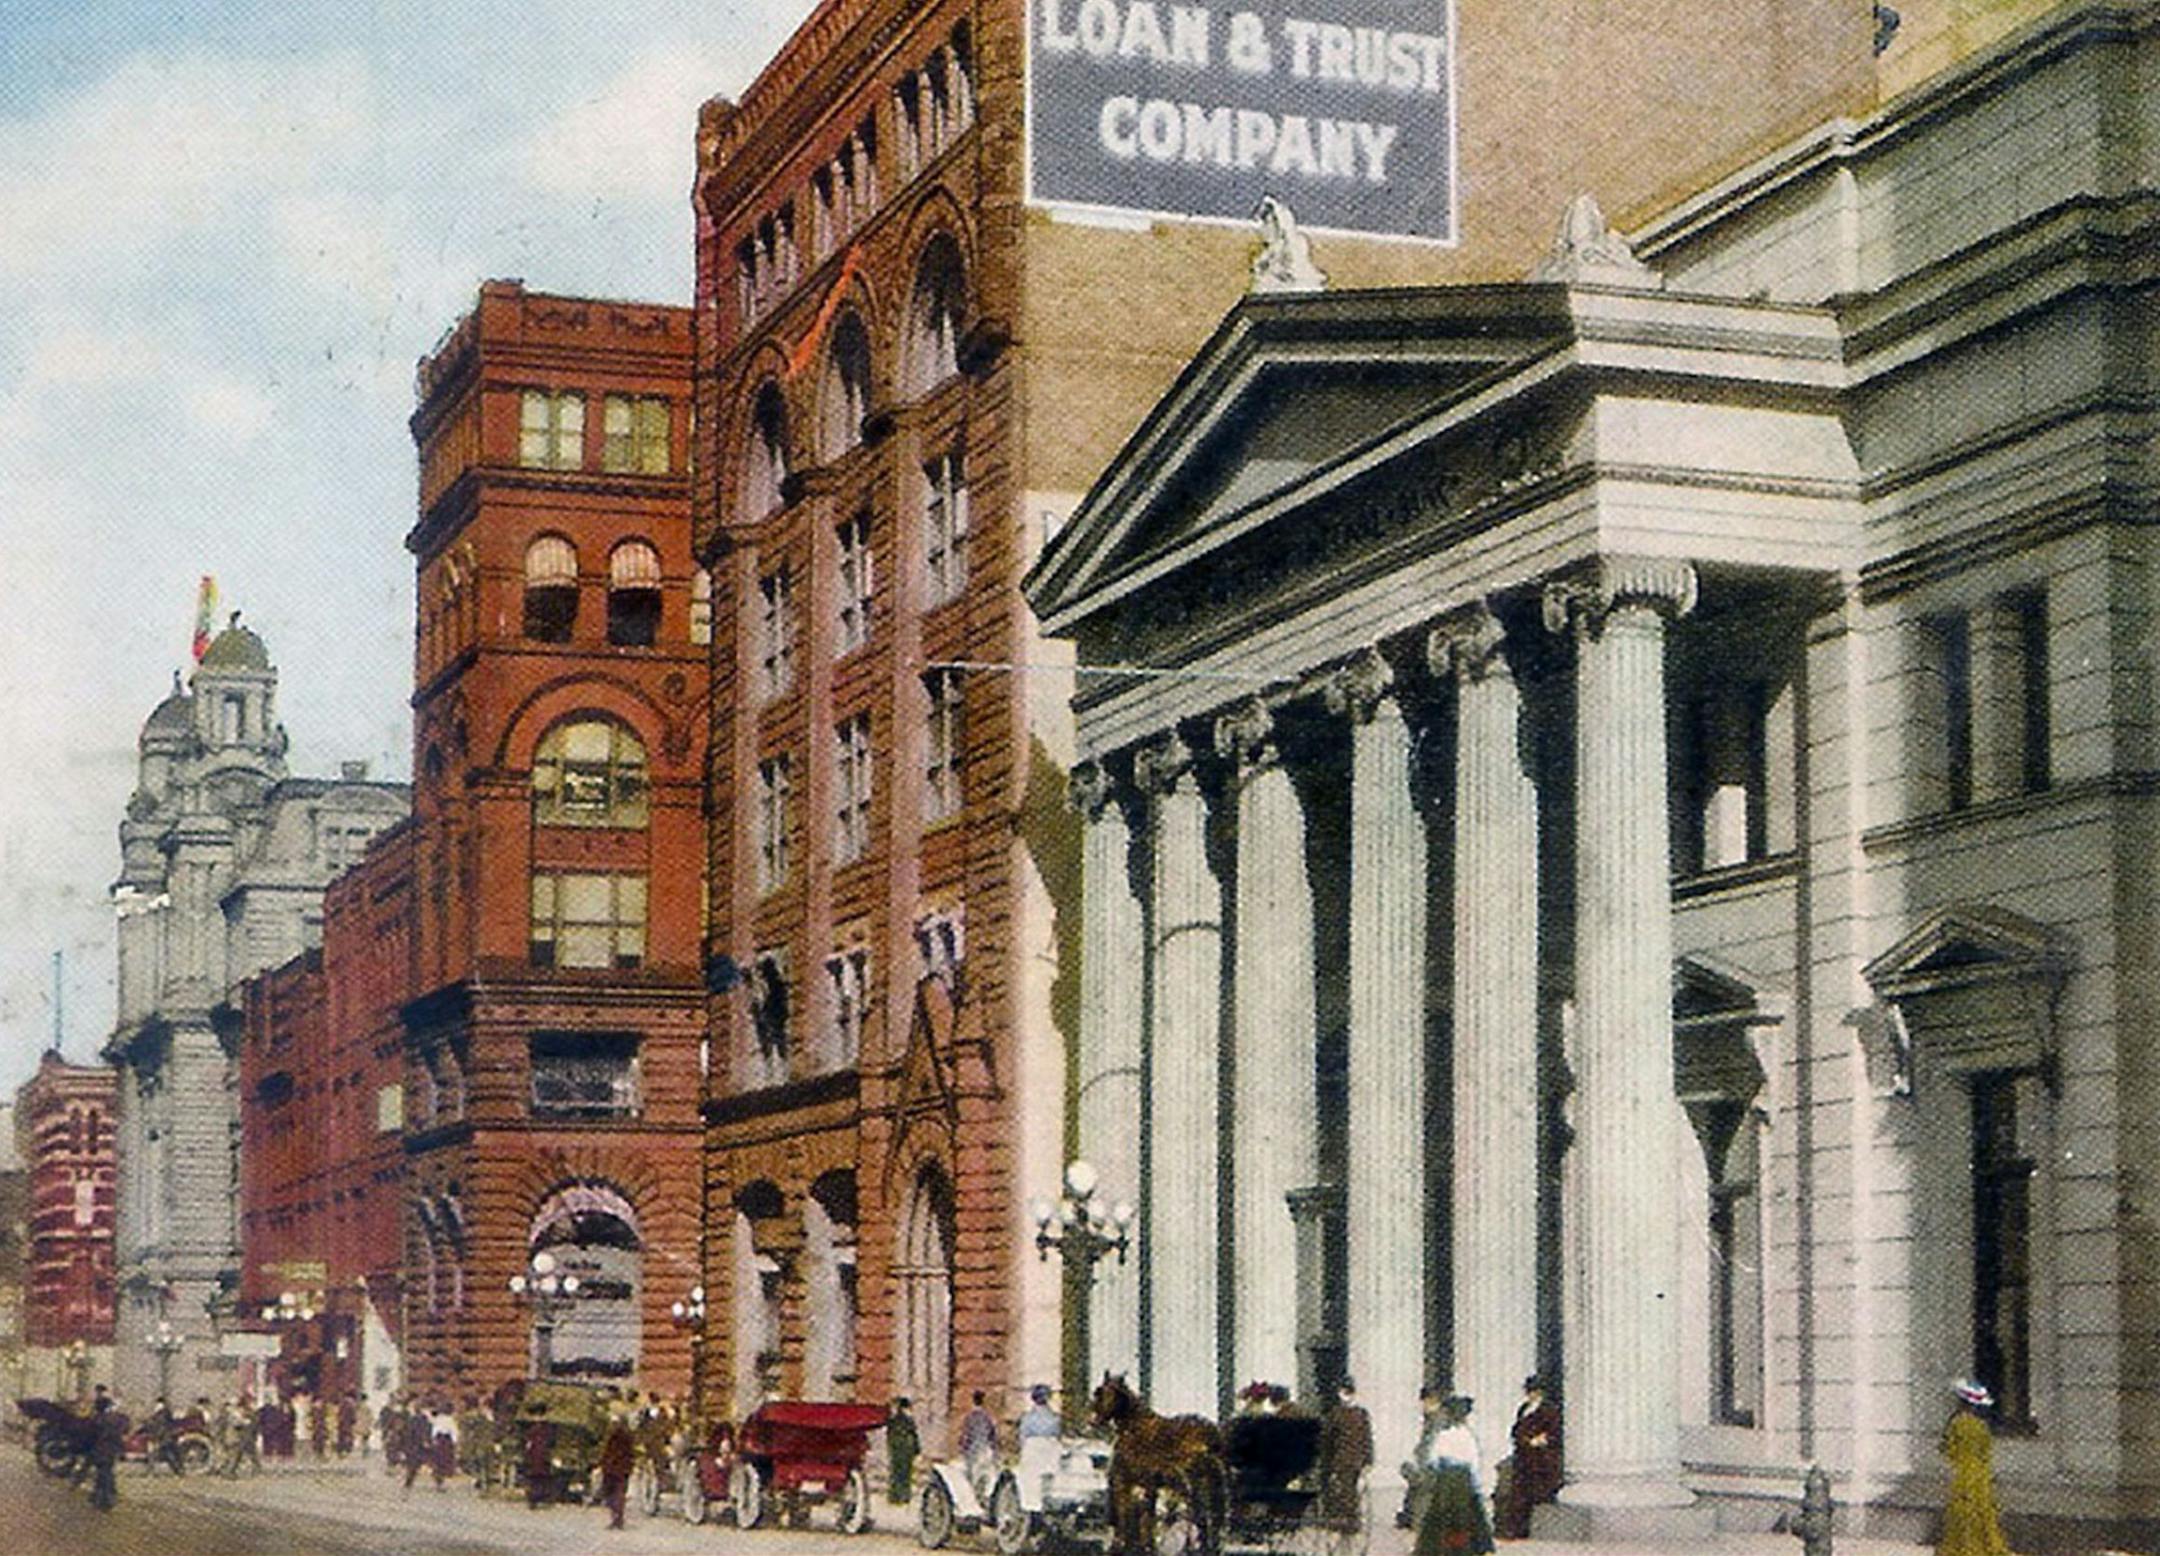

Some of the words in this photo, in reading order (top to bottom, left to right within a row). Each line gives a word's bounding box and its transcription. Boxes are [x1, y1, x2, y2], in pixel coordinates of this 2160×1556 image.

[1041, 0, 1209, 65] LOAN
[1227, 11, 1272, 73] &
[1283, 19, 1445, 92] TRUST
[1101, 95, 1398, 182] COMPANY
